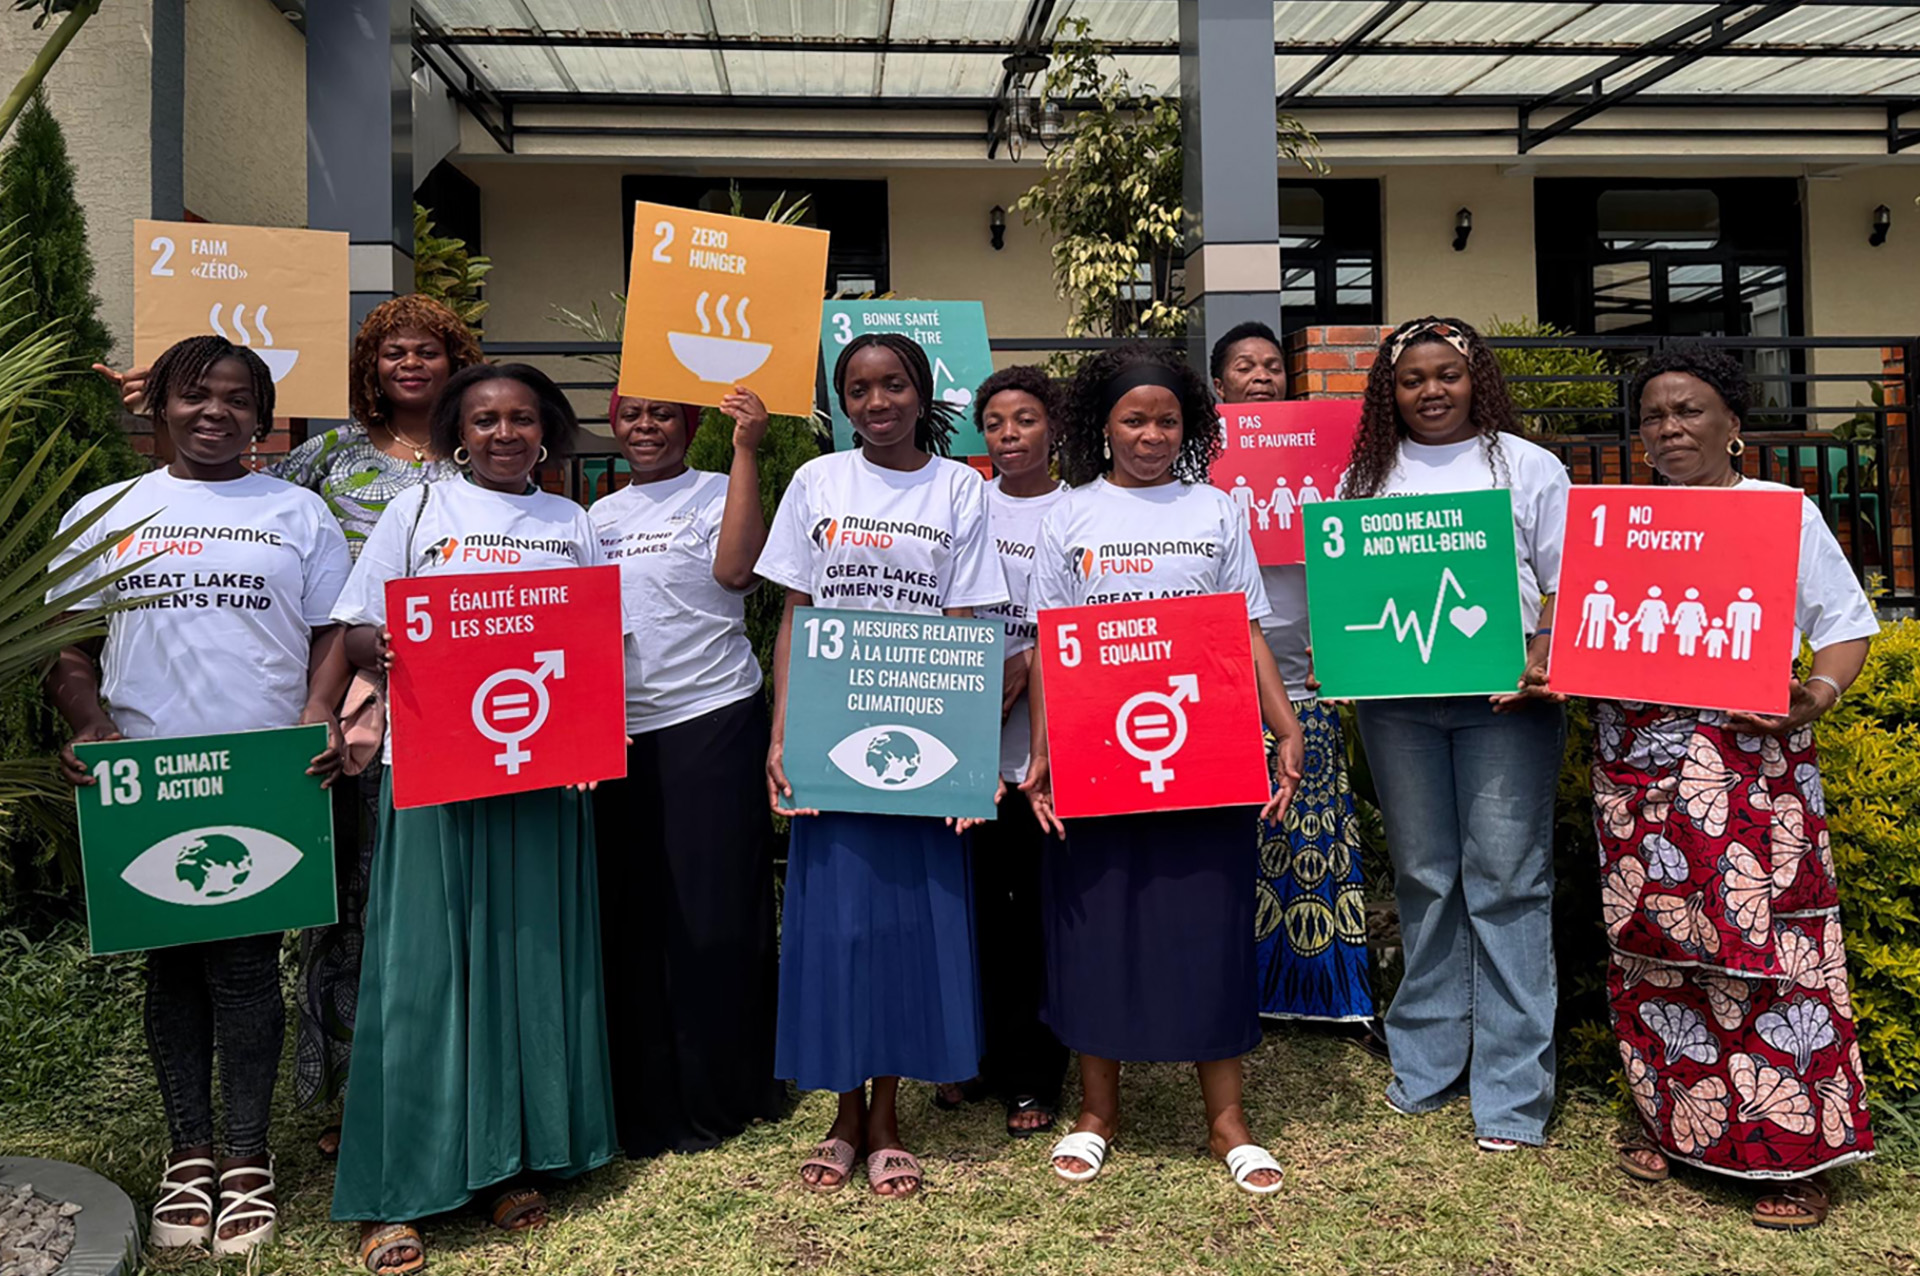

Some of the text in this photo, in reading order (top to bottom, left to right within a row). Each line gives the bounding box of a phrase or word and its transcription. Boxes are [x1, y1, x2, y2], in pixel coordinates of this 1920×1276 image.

[191, 239, 227, 256] FAIM
[652, 221, 674, 264] 2
[691, 226, 728, 249] ZERO
[151, 236, 175, 276] 2
[689, 248, 747, 275] HUNGER
[191, 258, 248, 279] «ZÉRO»
[832, 312, 853, 345] 3
[863, 309, 940, 326] BONNE SANTÉ
[1238, 415, 1262, 429] PAS
[1240, 428, 1317, 449] DE PAUVRETÉ
[1361, 508, 1463, 533] GOOD HEALTH
[1591, 504, 1606, 547] 1
[1629, 505, 1652, 525] NO
[141, 526, 283, 547] MWANAMKE
[840, 531, 893, 549] FUND
[842, 515, 953, 550] MWANAMKE
[1322, 516, 1345, 558] 3
[1363, 530, 1487, 556] AND WELL-BEING
[1626, 529, 1705, 552] POVERTY
[137, 540, 204, 556] FUND
[462, 547, 521, 565] FUND
[464, 534, 576, 560] MWANAMK
[626, 543, 667, 557] LAKES
[1100, 541, 1215, 558] MWANAMKE
[883, 566, 938, 588] LAKES
[1100, 558, 1154, 575] FUND
[115, 573, 266, 592] GREAT LAKES
[216, 593, 272, 610] FUND
[450, 585, 569, 612] ÉGALITÉ ENTRE
[406, 595, 433, 642] 5
[451, 614, 535, 638] LES SEXES
[1097, 617, 1158, 640] GENDER
[804, 618, 845, 660] 13
[852, 620, 995, 644] MESURES RELATIVES
[851, 640, 985, 667] À LA LUTTE CONTRE
[1057, 623, 1082, 668] 5
[1100, 640, 1172, 666] EQUALITY
[849, 668, 985, 692] LES CHANGEMENTS
[847, 693, 944, 716] CLIMATIQUES
[155, 750, 231, 776] CLIMATE
[93, 758, 142, 806] 13
[157, 776, 223, 801] ACTION
